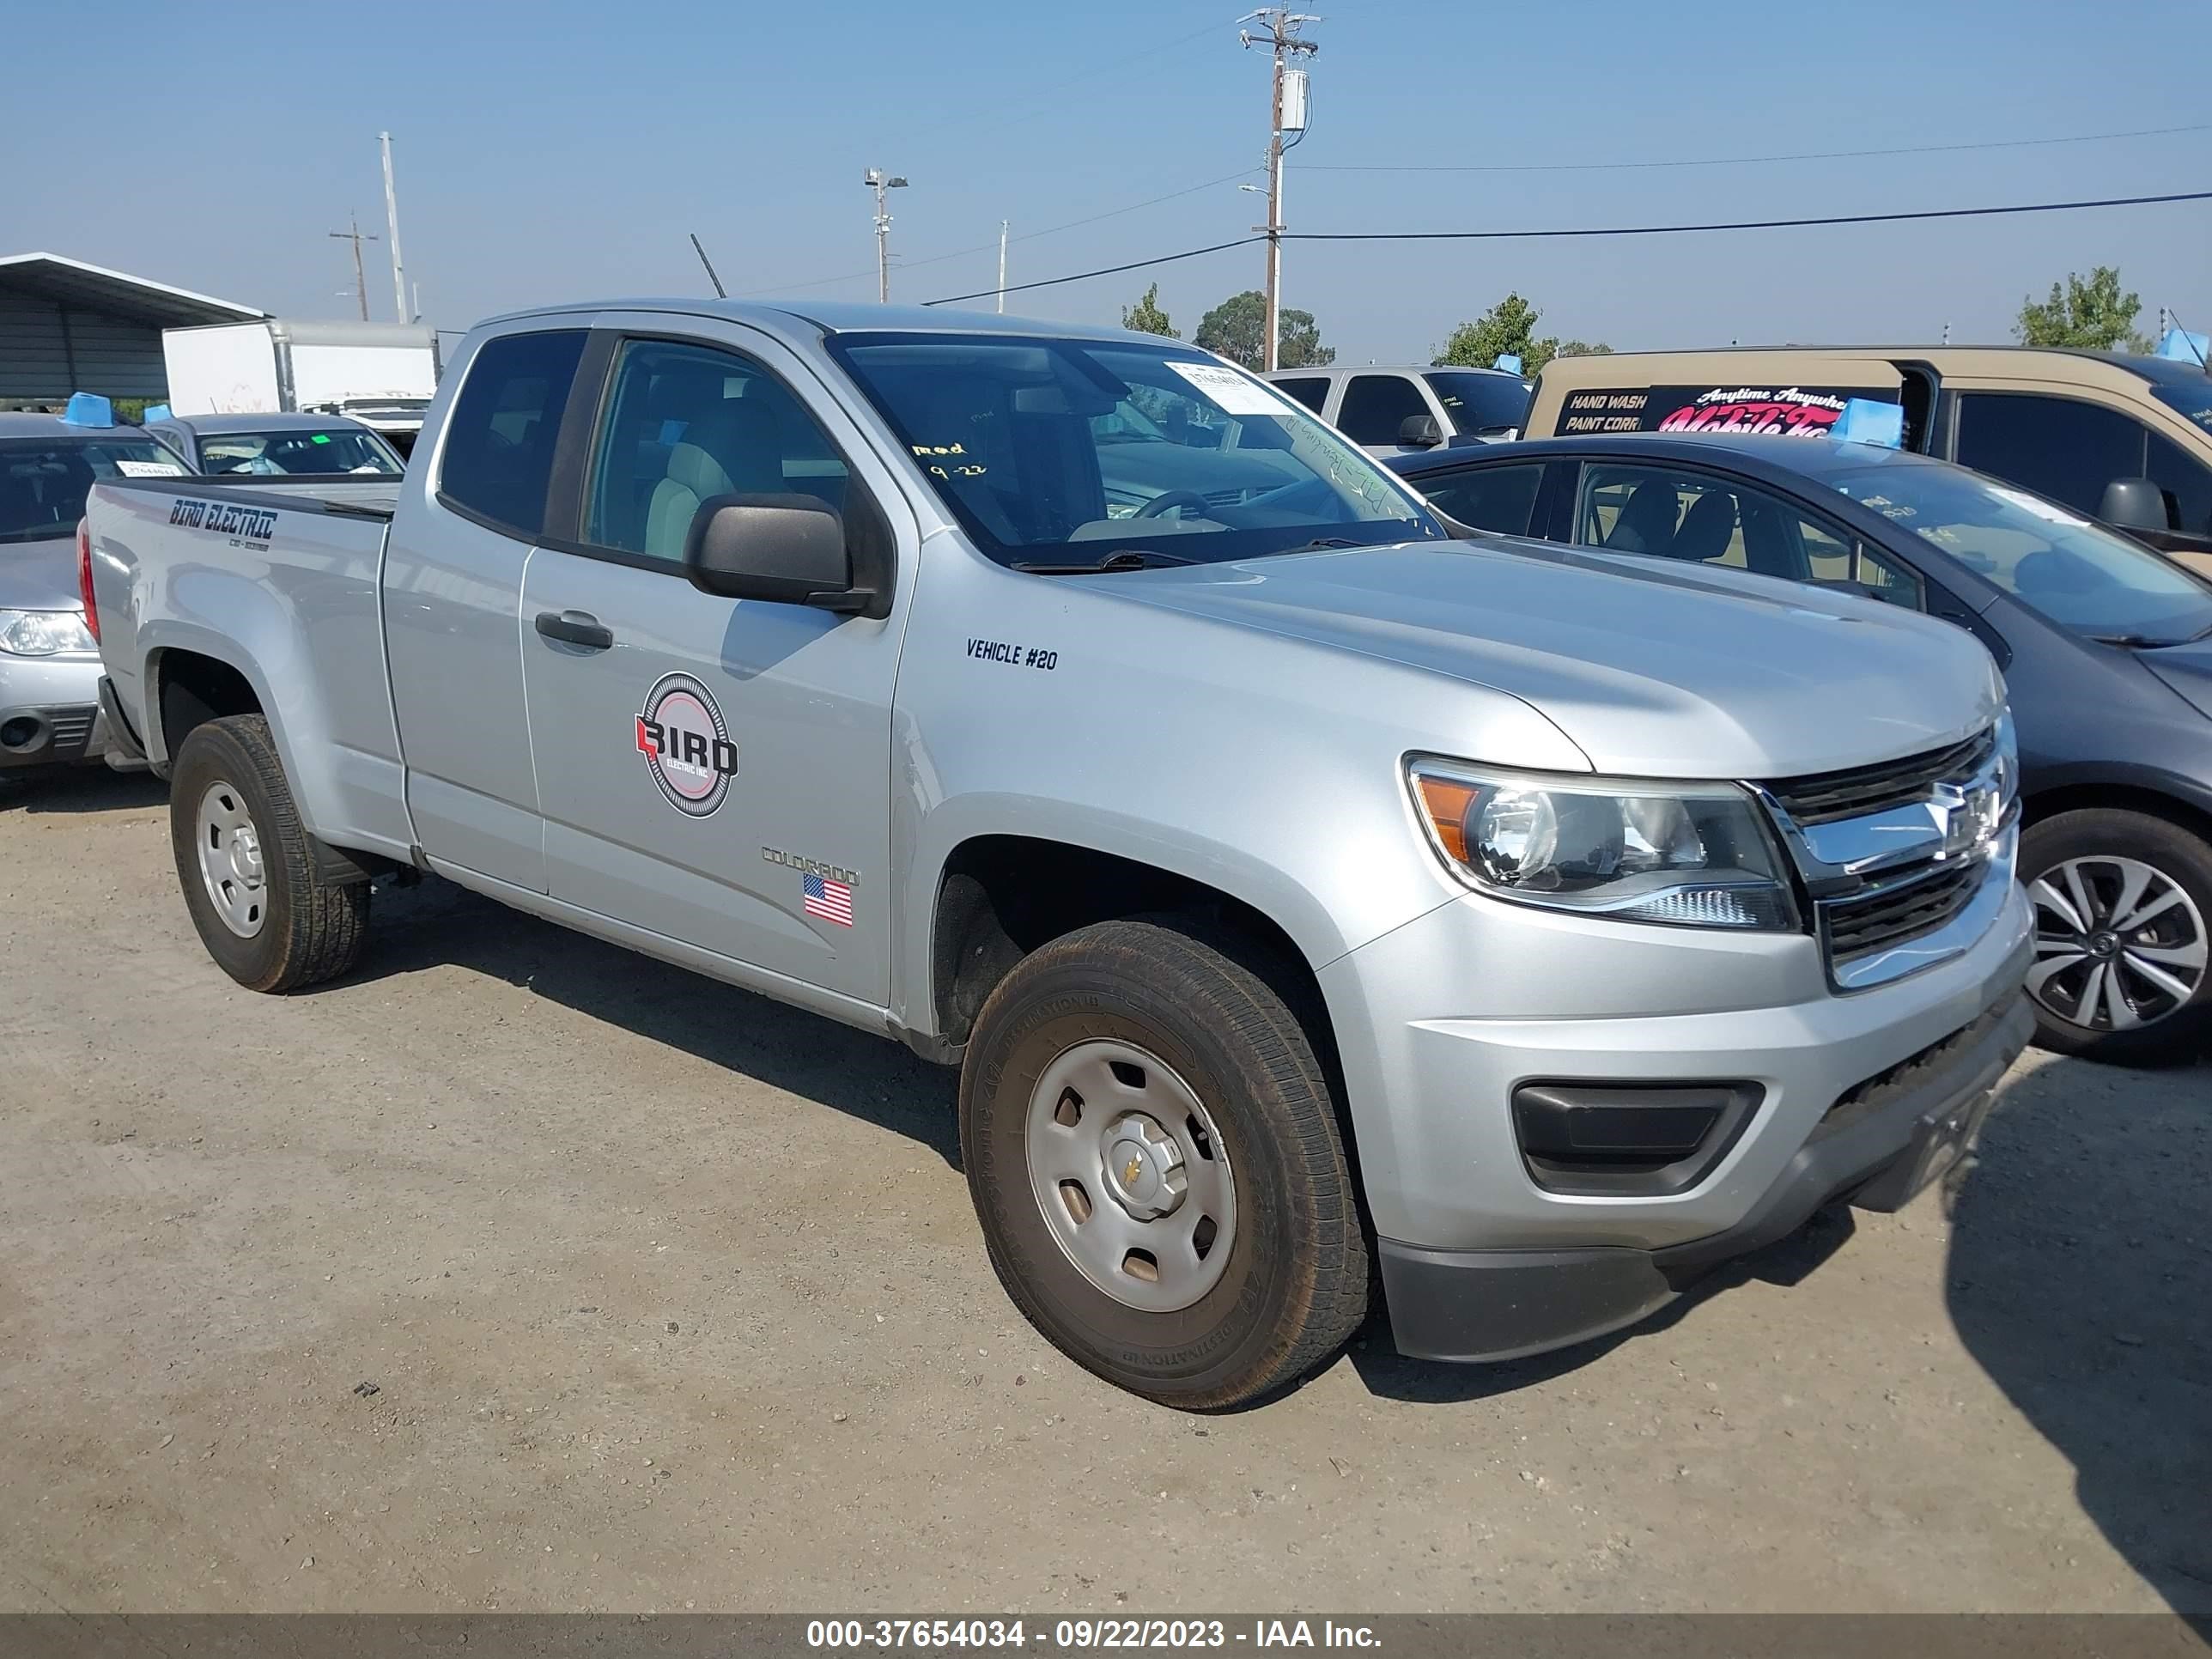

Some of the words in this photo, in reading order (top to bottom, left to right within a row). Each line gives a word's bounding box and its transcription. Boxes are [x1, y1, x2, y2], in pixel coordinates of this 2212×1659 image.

[1570, 395, 1607, 409] HAND
[1607, 395, 1648, 409] WASH
[1697, 388, 1771, 406] Anytime
[1565, 416, 1604, 430] PAINT
[1658, 405, 1784, 434] Mobile
[169, 500, 207, 528] BIRD
[205, 504, 277, 539] ELECTRIC
[967, 638, 1022, 665] VEHICLE
[1025, 648, 1058, 670] #20
[637, 717, 738, 775] BIRD
[666, 757, 696, 775] ELECTRIC
[763, 847, 861, 886] COLORADO
